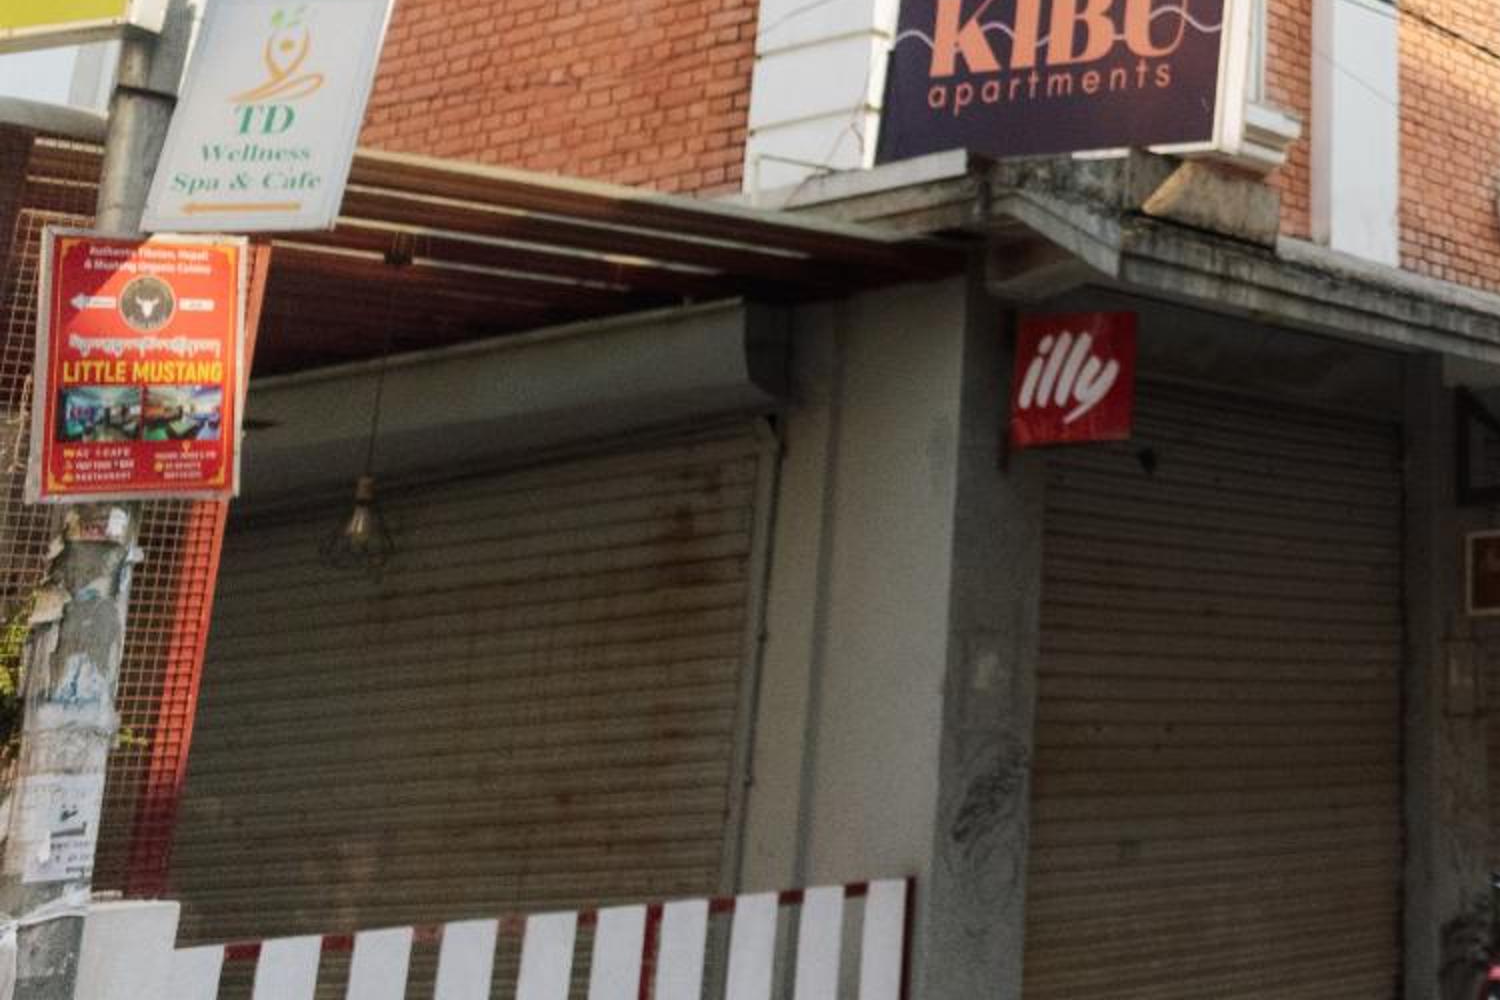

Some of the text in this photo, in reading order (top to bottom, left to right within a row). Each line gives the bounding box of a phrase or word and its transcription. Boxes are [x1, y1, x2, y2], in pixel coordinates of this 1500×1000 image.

[928, 60, 1172, 116] apartments
[233, 103, 296, 134] TD
[200, 143, 312, 162] Wellness
[171, 170, 322, 196] Spa & Cafe
[63, 360, 223, 383] LITTLE MUSTANG
[1018, 330, 1120, 424] illy
